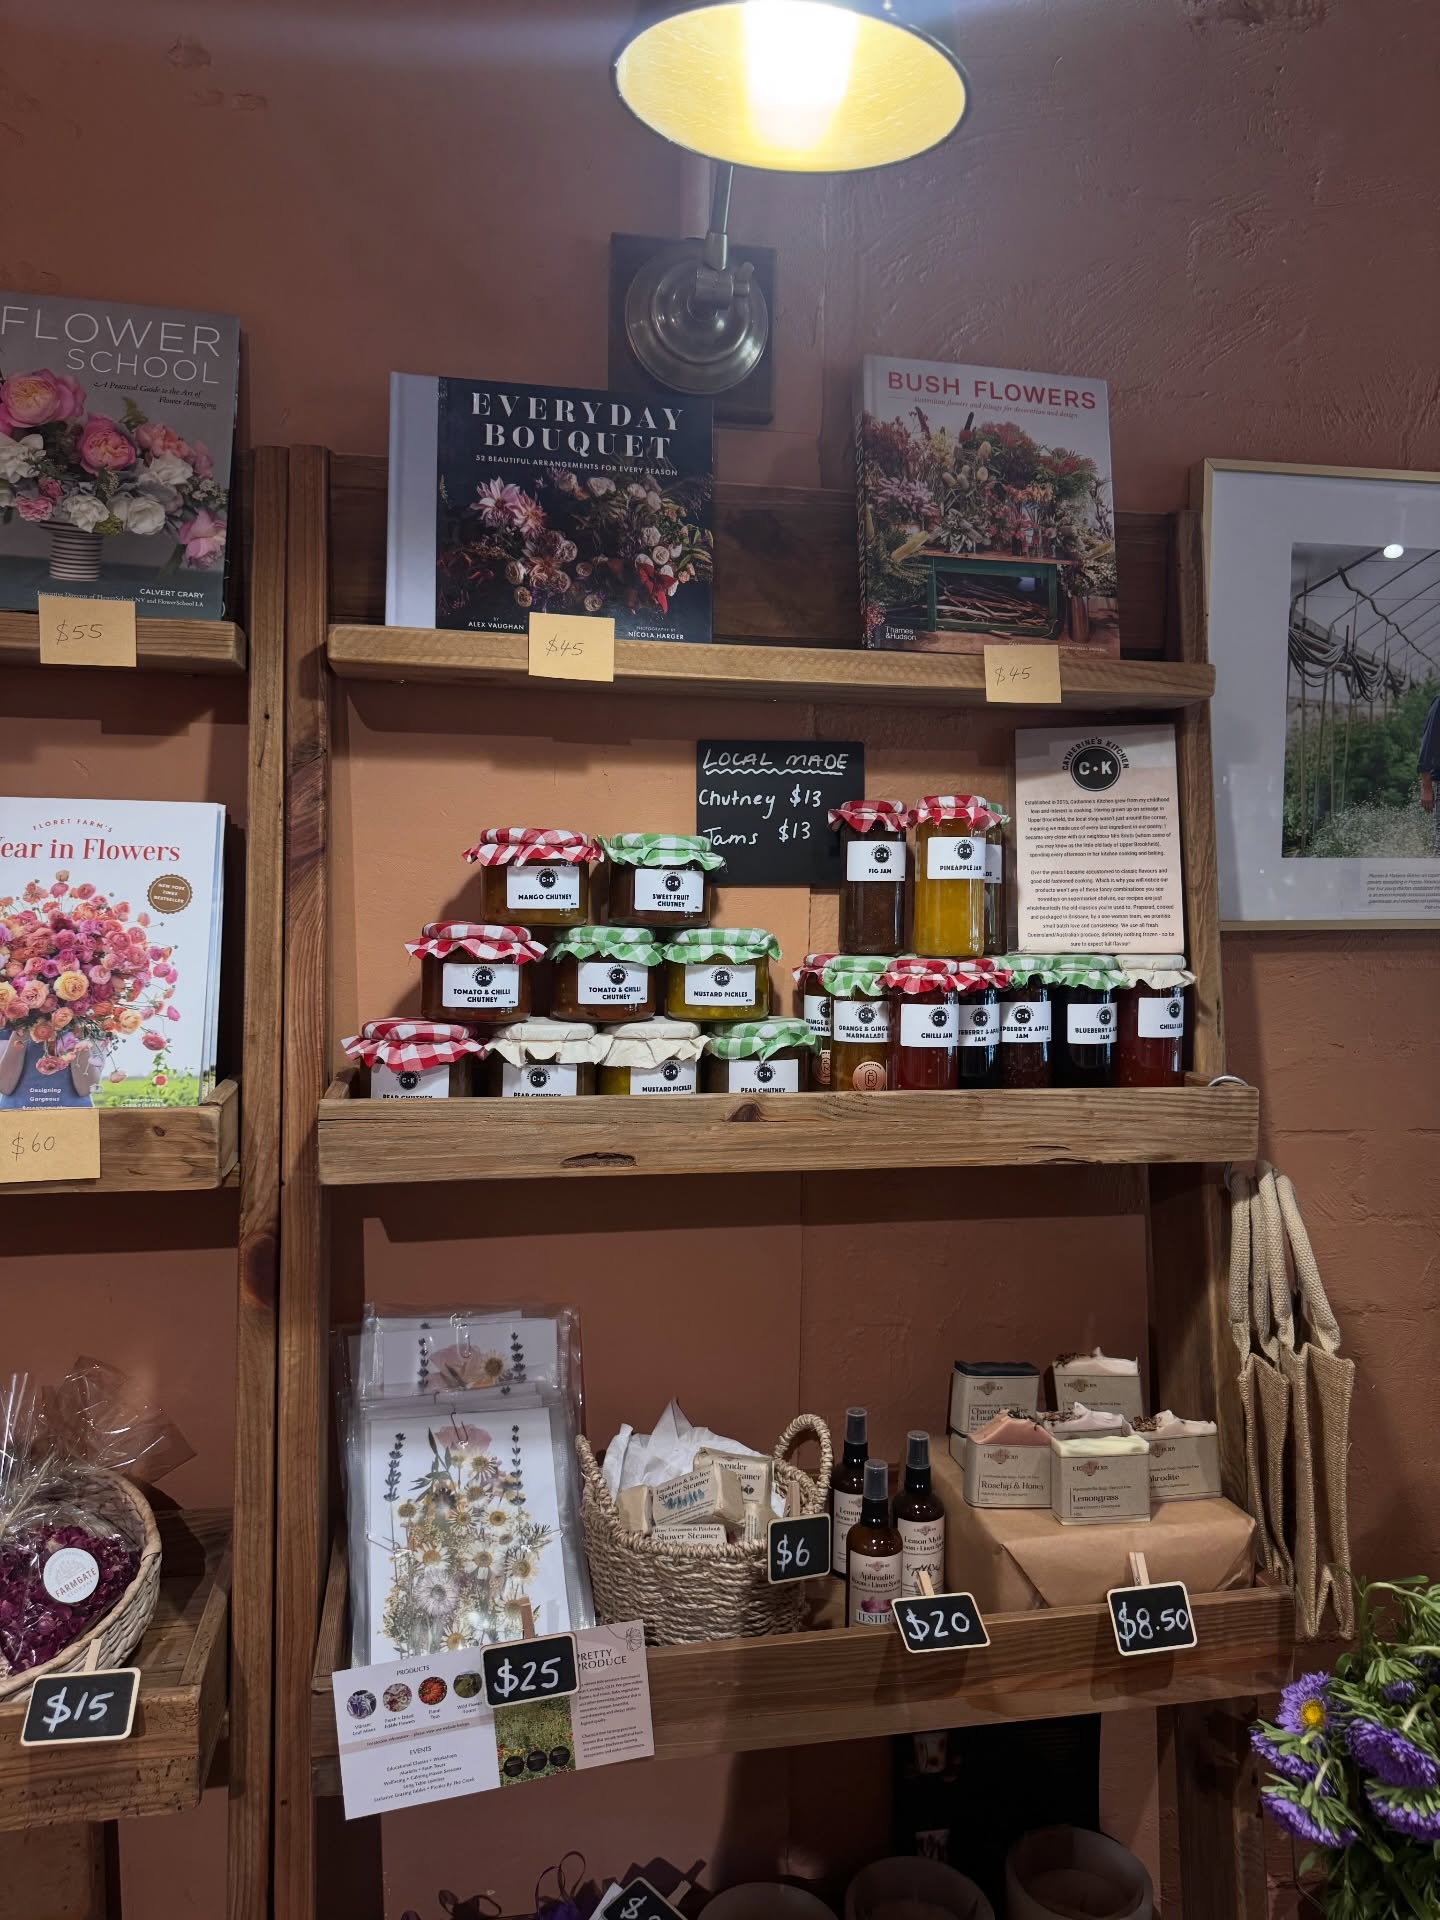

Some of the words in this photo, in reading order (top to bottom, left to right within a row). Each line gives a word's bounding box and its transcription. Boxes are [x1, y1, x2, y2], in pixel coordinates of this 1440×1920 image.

[1, 306, 220, 357] FLOWER
[66, 348, 219, 384] SCHOOL
[109, 382, 138, 391] Practical
[139, 385, 160, 393] Guide
[168, 387, 180, 395] the
[180, 388, 193, 397] Art
[194, 389, 202, 398] of
[888, 371, 960, 396] BUSH
[974, 380, 1096, 410] FLOWERS
[159, 397, 182, 405] Flower
[183, 399, 217, 410] Arranging
[472, 392, 684, 431] EVERYDAY
[484, 423, 671, 458] BOUQUET
[475, 454, 486, 462] 52
[488, 455, 531, 465] BEAUTIFUL
[533, 459, 599, 471] ARRANGEMENTS
[601, 464, 617, 472] FOR
[619, 466, 644, 474] EVERY
[645, 467, 679, 477] SEASON
[140, 588, 175, 597] CALVERT
[177, 591, 204, 599] CRARY
[158, 599, 194, 607] FlowerSchool
[56, 619, 103, 646] $55
[468, 621, 486, 629] ALEX
[487, 622, 525, 631] VAUGHAN
[628, 631, 655, 639] NICOLA
[656, 632, 684, 640] HARGER
[885, 625, 914, 634] Thames
[545, 633, 585, 657] $45
[995, 665, 1033, 686] $45
[702, 749, 773, 770] LOCAL
[785, 753, 849, 770] MADE
[1062, 737, 1102, 771] CATHERINE'S
[1105, 740, 1130, 769] KITCHEN
[698, 788, 776, 820] Chutney
[789, 783, 822, 808] $13
[33, 818, 71, 831] FLORET
[76, 818, 113, 833] FARM'S
[778, 818, 811, 843] $13
[50, 839, 75, 860] in
[82, 838, 180, 862] Flowers
[153, 895, 185, 903] BESTSELLER
[652, 893, 671, 901] SWEET
[657, 900, 686, 908] CHUTNEY
[693, 990, 723, 998] MUSTARD
[724, 990, 748, 998] PICKLES
[29, 1096, 60, 1104] Gorgeous
[30, 1087, 62, 1095] Designing
[12, 1131, 56, 1162] $60
[658, 1488, 681, 1501] Shower
[683, 1478, 710, 1492] Steamer
[981, 1481, 1012, 1491] Rosehip
[1022, 1482, 1044, 1491] Honey
[1073, 1494, 1119, 1503] Lemongrass
[657, 1533, 685, 1541] Shower
[904, 1535, 927, 1545] Lemon
[776, 1534, 810, 1573] $6
[55, 1567, 97, 1598] FARMGATE
[860, 1571, 894, 1581] Aphrodite
[906, 1608, 970, 1641] $20
[1118, 1601, 1189, 1647] $8.50
[396, 1665, 430, 1676] PRODUCTS
[493, 1656, 561, 1698] $25
[42, 1686, 115, 1734] $15
[409, 1745, 432, 1756] EVENTS
